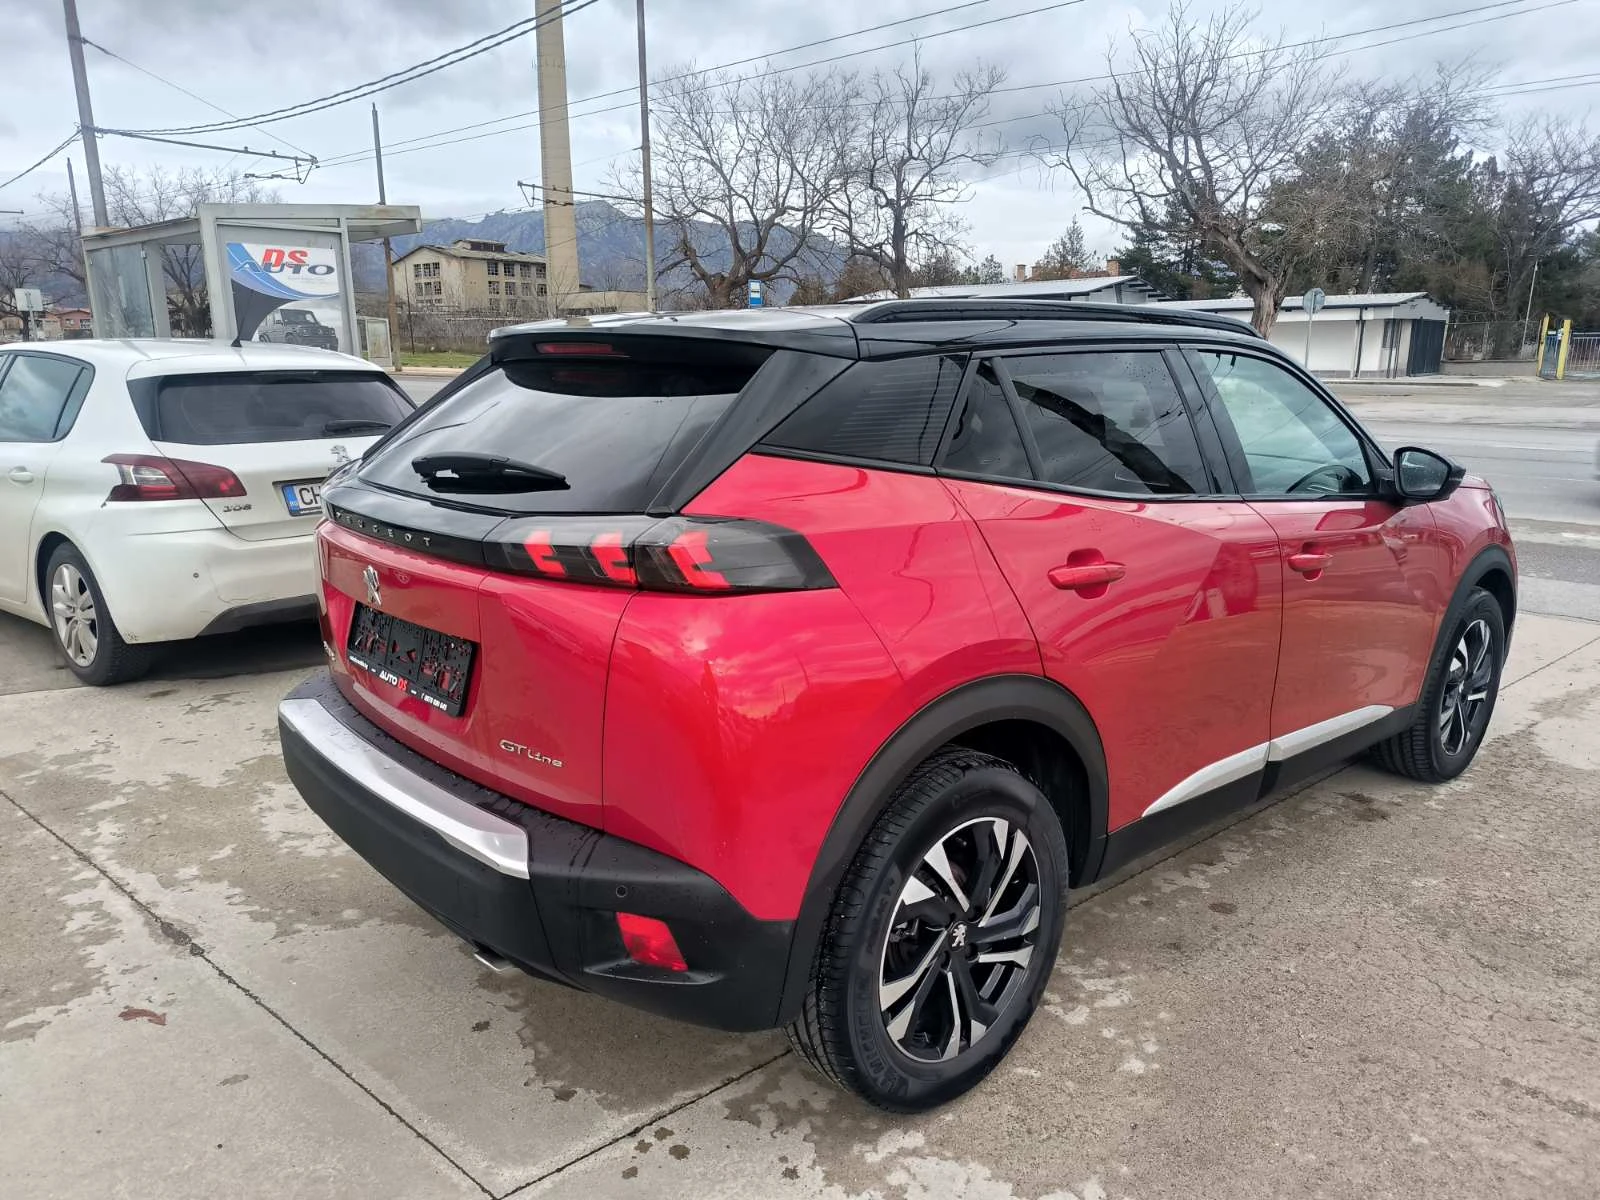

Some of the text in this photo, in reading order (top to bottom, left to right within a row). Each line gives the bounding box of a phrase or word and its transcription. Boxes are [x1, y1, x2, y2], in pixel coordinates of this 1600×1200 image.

[233, 260, 335, 275] AUTO
[262, 248, 309, 268] DS
[379, 670, 408, 691] AUTO DS
[499, 739, 563, 768] GT Line
